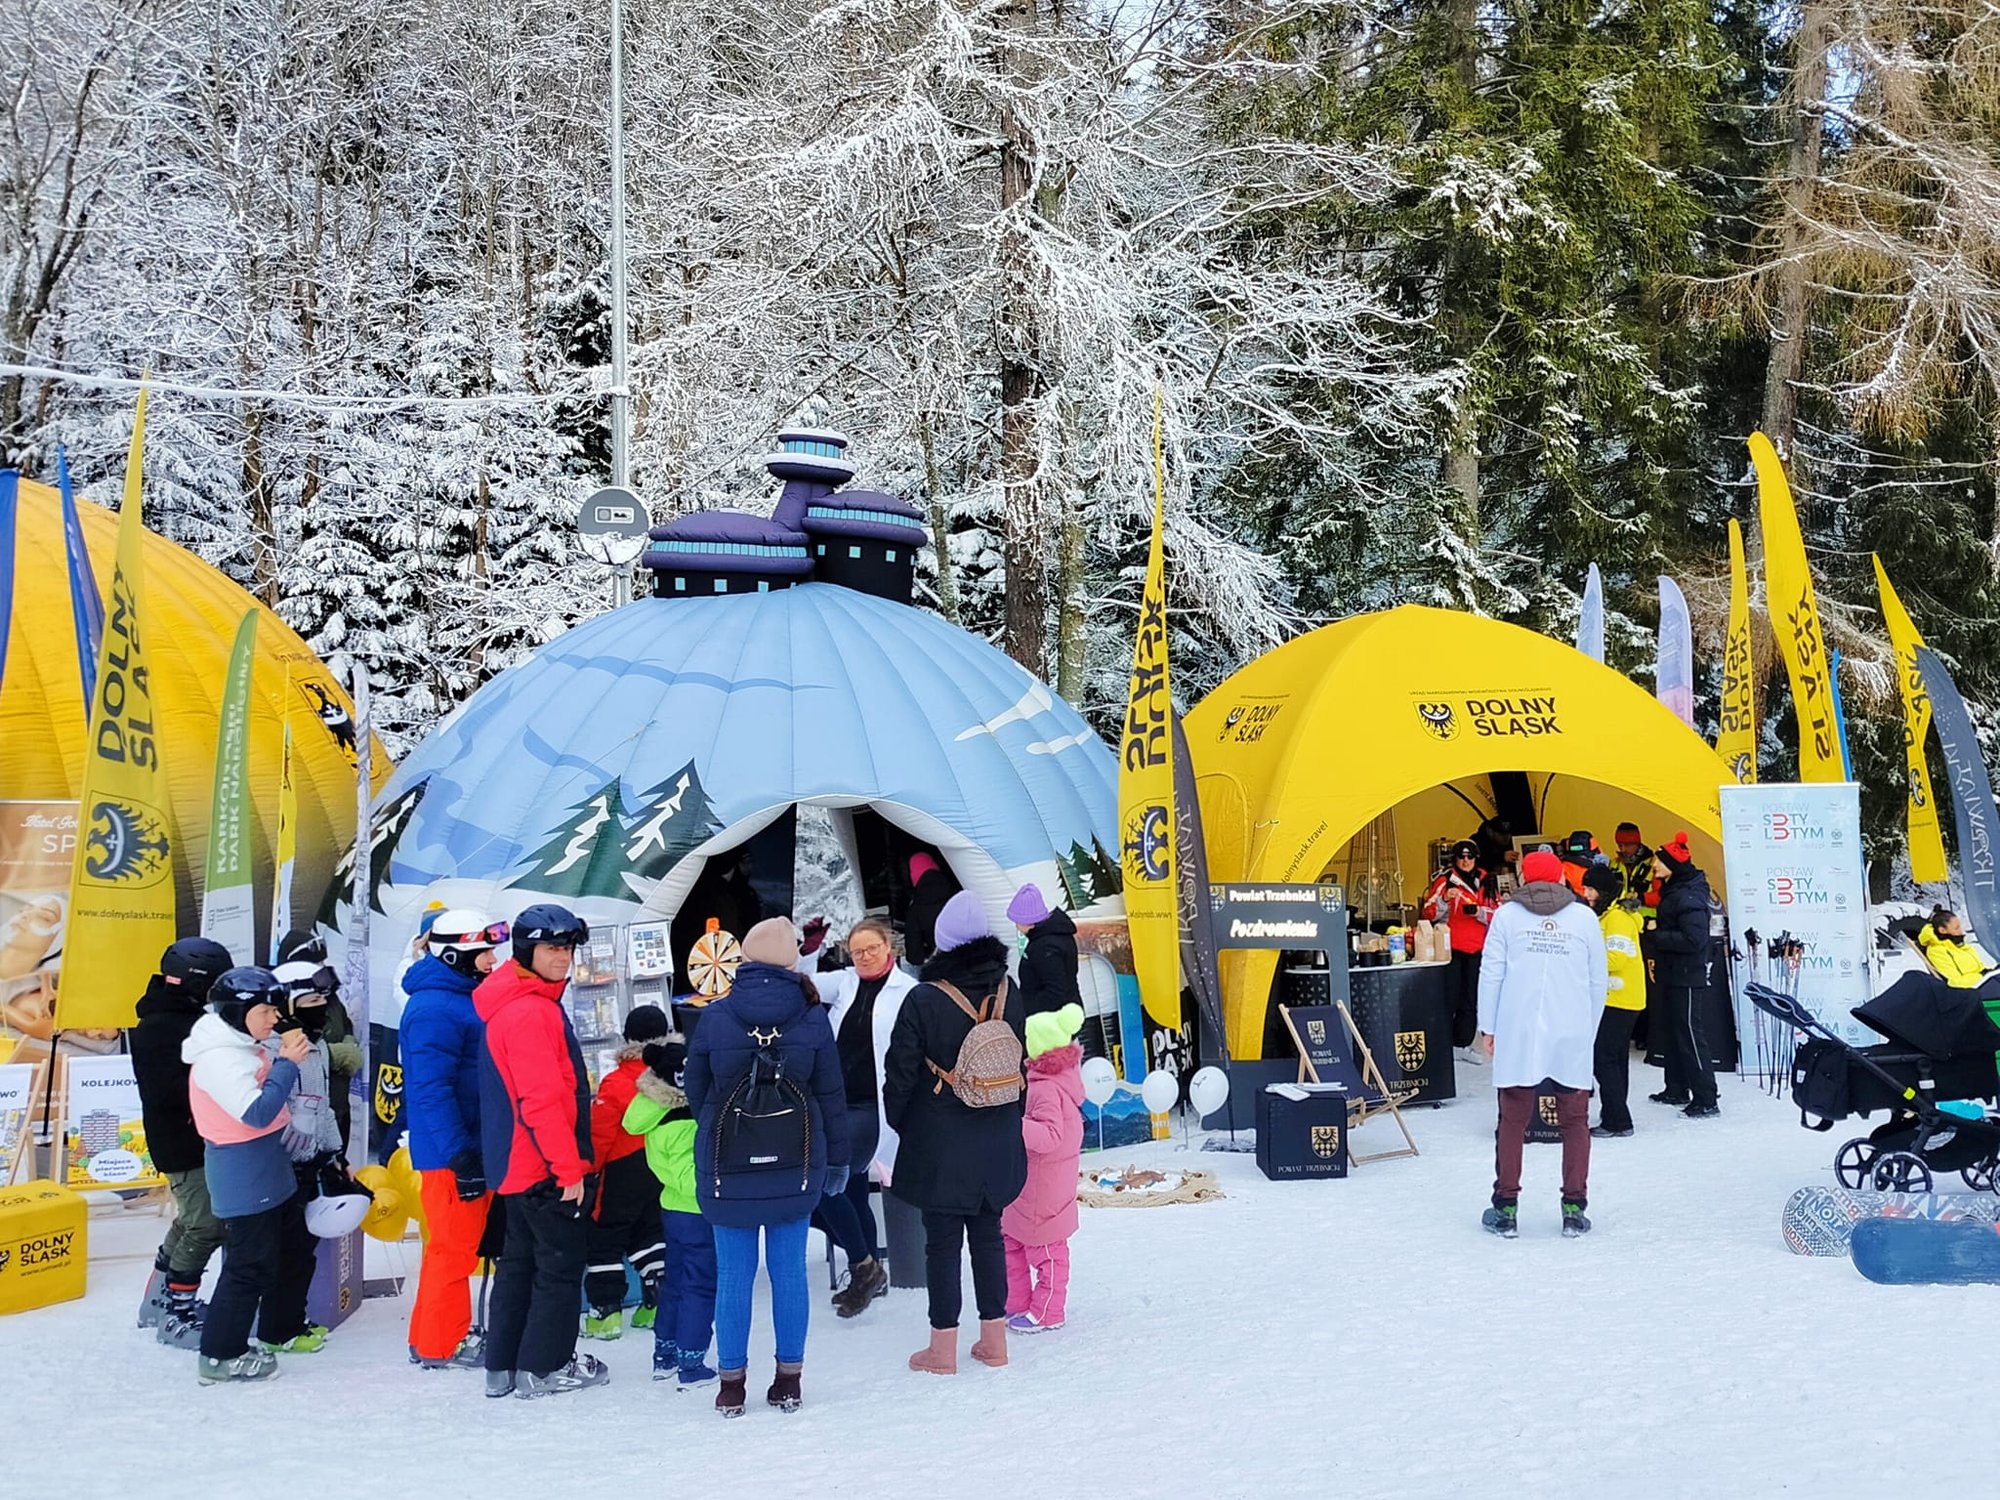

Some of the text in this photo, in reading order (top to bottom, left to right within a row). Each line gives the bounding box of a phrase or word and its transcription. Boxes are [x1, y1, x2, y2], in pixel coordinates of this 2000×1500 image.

[97, 560, 130, 763] DOLNY
[1246, 703, 1284, 722] DOLNY
[1466, 697, 1556, 716] DOLNY
[1474, 713, 1563, 738] ŚLĄSK
[229, 805, 240, 872] PARK
[1766, 866, 1815, 877] POSTAW
[1229, 889, 1316, 902] Powiat Trzebnicki
[1229, 918, 1318, 938] Pozdrowienia
[1801, 956, 1833, 969] TYM
[1277, 1164, 1340, 1173] POWIAT TRZEBNICKI
[20, 1232, 75, 1255] DOLNY
